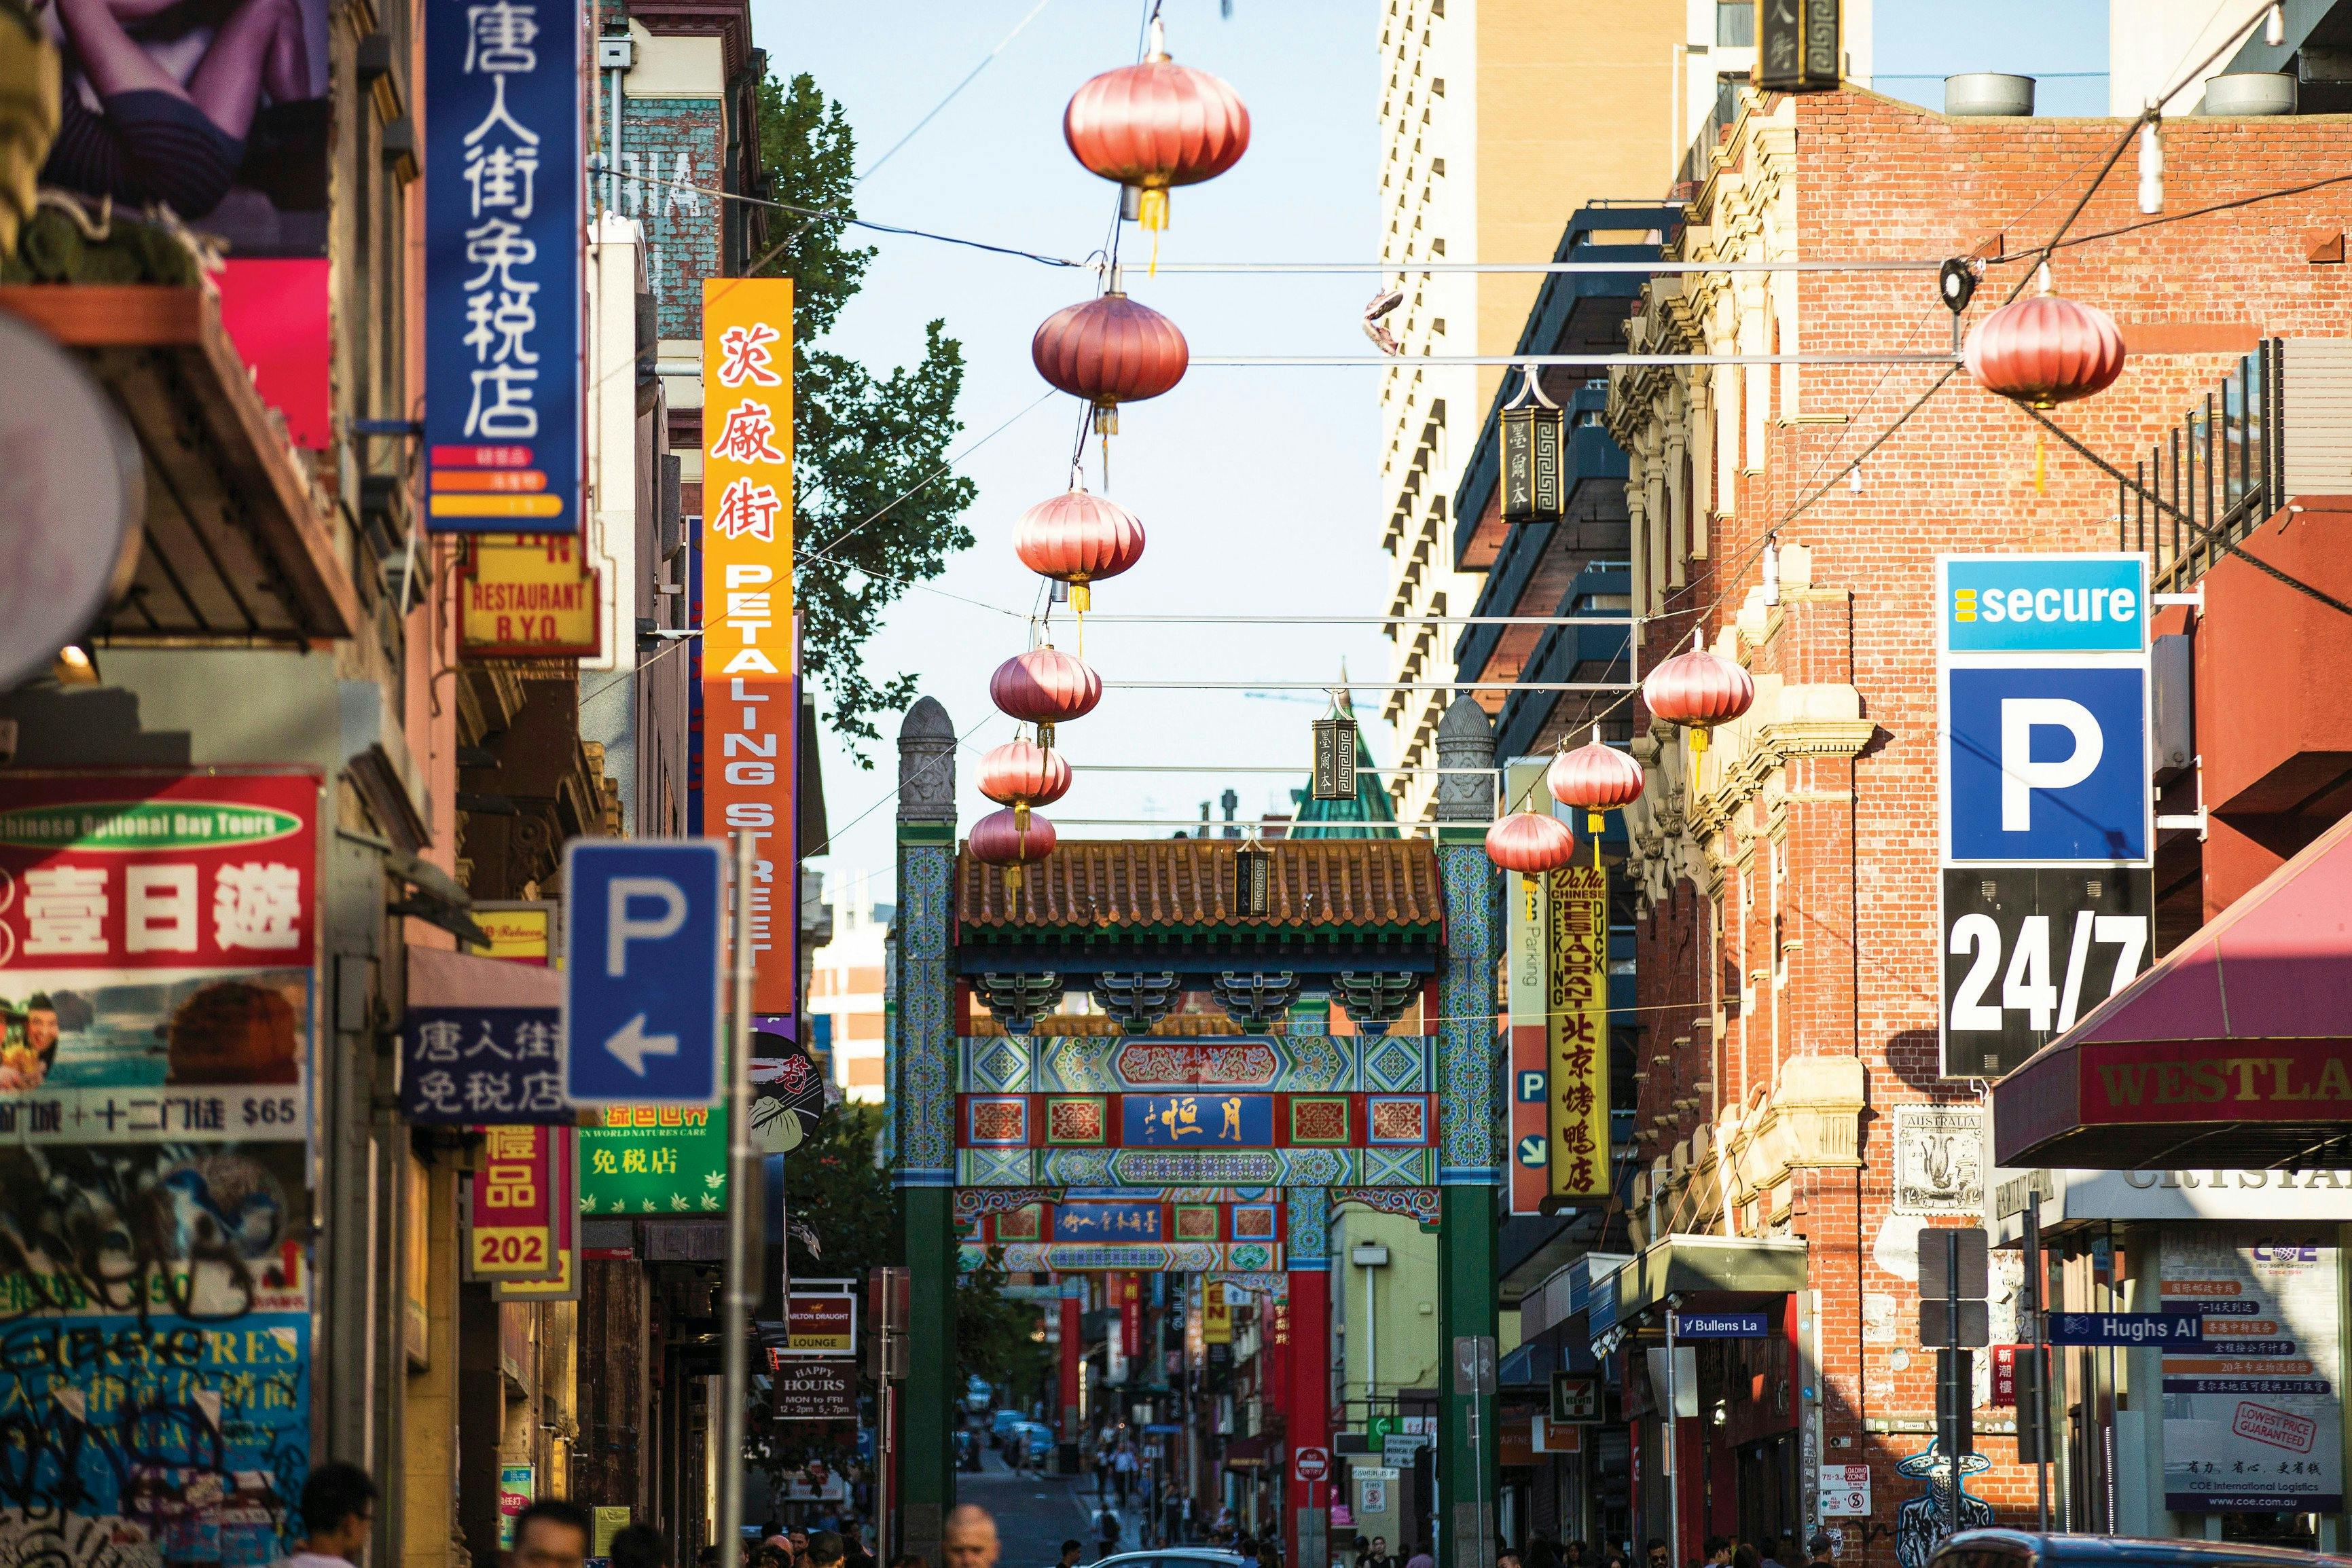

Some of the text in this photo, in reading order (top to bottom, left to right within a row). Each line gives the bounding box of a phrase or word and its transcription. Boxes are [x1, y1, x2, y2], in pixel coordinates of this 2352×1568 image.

[1510, 422, 1528, 509] 墨爾本
[473, 583, 584, 610] RESTAURANT
[1982, 587, 2135, 623] secure
[723, 564, 778, 786] PETALING
[1320, 729, 1331, 790] 墨爾本
[2002, 698, 2103, 832] P
[1551, 890, 1605, 899] CHINESE
[607, 878, 687, 977] P
[1522, 926, 1540, 987] Parking
[1553, 900, 1604, 1006] PEKING DUCK
[1950, 911, 2148, 1033] 24/7
[1523, 1074, 1544, 1099] P
[2098, 1057, 2352, 1107] WESTLA
[243, 1098, 296, 1127] $65
[1907, 1116, 1977, 1127] AUSTRALIA
[592, 1147, 677, 1174] 免税店
[481, 1236, 542, 1263] 202
[1696, 1319, 1757, 1332] Bullens La
[2103, 1318, 2168, 1340] Hughs
[793, 1339, 837, 1347] LOUNGE
[784, 1379, 845, 1391] HOURS
[795, 1366, 835, 1379] HAPPY
[2241, 1407, 2310, 1436] LOWEST PRICE
[2241, 1421, 2305, 1446] GUARANTEED
[2190, 1482, 2319, 1493] COE International Logistics
[2209, 1498, 2297, 1506] www.coe.com.au
